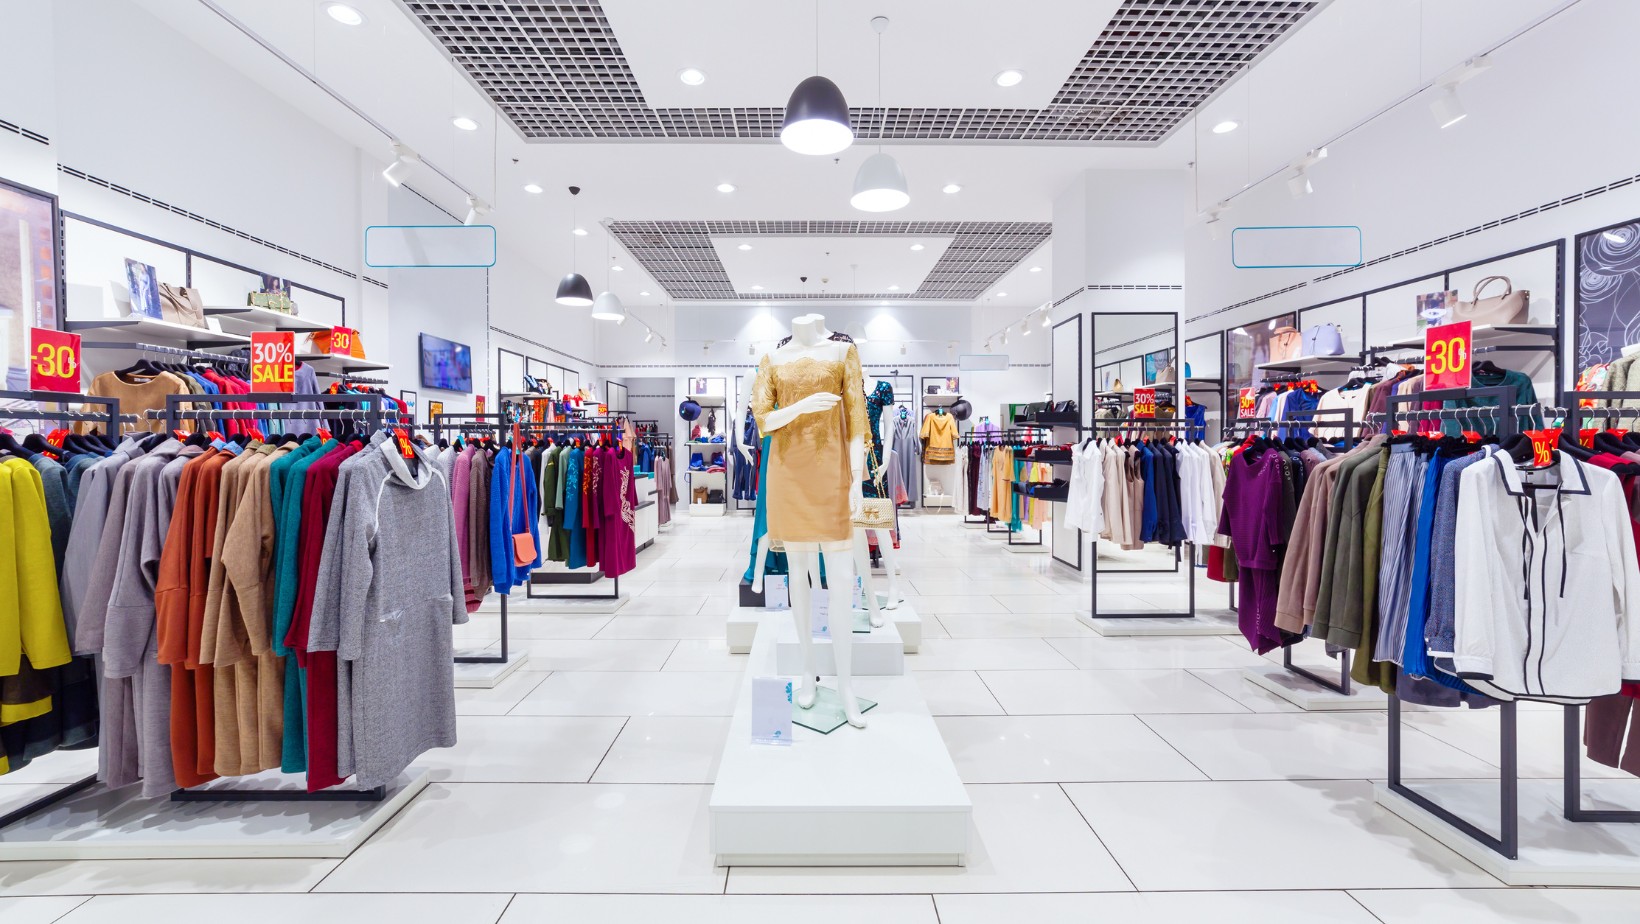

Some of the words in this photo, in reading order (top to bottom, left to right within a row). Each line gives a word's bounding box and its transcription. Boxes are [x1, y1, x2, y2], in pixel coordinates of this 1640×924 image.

[253, 342, 293, 363] 30%
[253, 364, 294, 383] SALE
[1135, 393, 1155, 404] 30%
[1134, 404, 1155, 415] SALE
[1240, 408, 1255, 417] SALE
[400, 438, 413, 455] %
[1535, 441, 1550, 462] %
